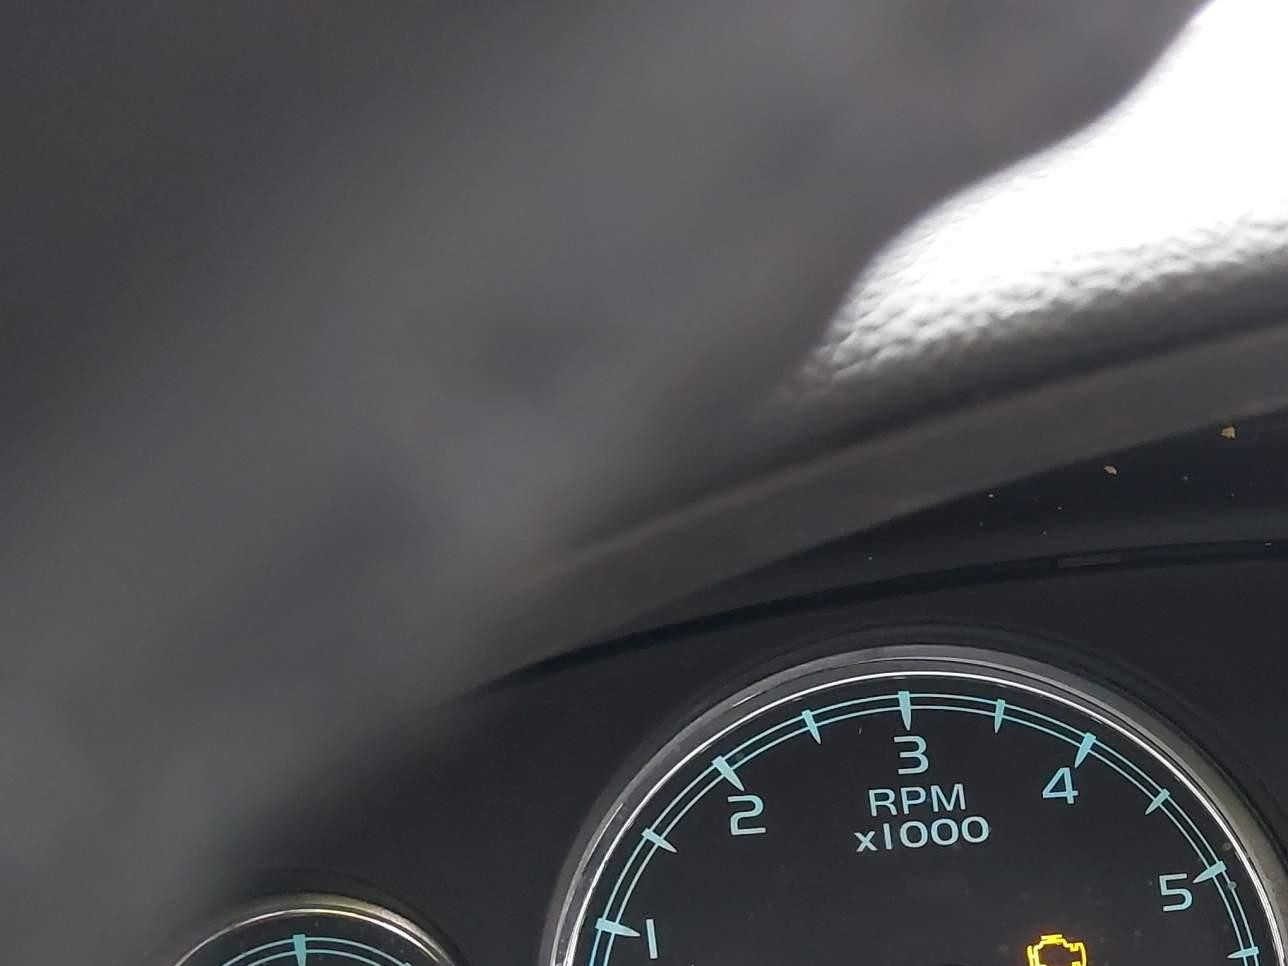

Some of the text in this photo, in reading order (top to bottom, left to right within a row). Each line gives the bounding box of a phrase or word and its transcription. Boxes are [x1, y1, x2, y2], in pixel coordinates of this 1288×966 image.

[893, 736, 929, 774] 3
[868, 783, 966, 816] RPM
[1042, 767, 1078, 804] 4
[728, 795, 766, 835] 2
[855, 816, 990, 852] x1000
[1159, 874, 1193, 911] 5
